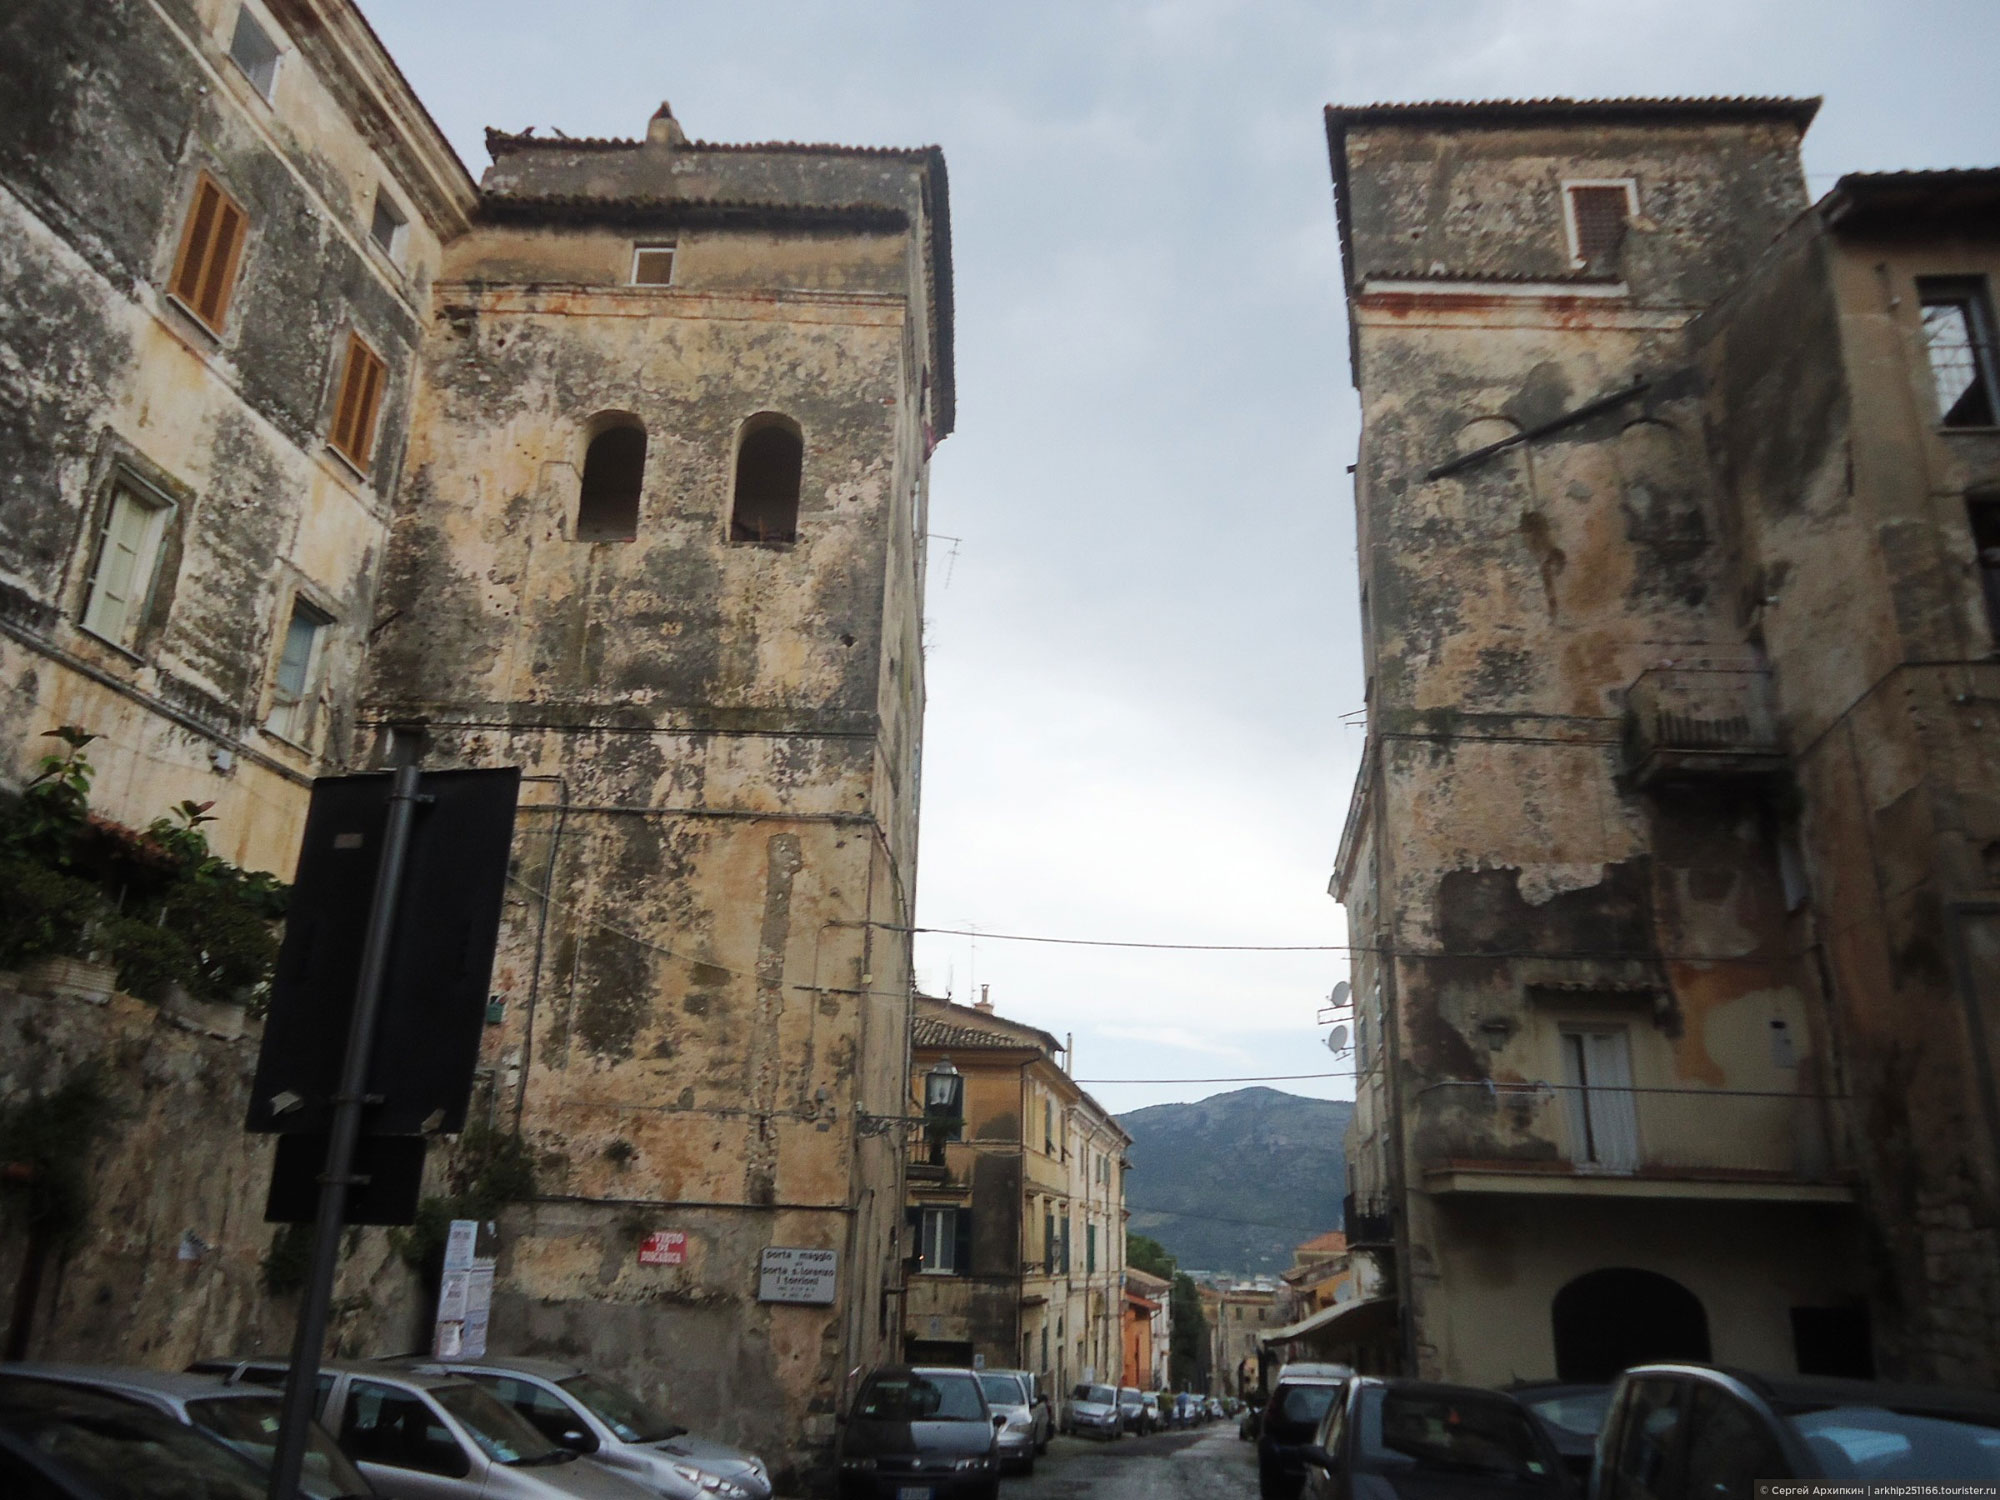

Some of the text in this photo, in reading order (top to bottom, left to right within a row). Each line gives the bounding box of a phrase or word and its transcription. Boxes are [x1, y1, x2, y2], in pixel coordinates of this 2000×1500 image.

[766, 1250, 792, 1259] porta
[762, 1266, 788, 1275] porta
[784, 1276, 819, 1285] torrioni
